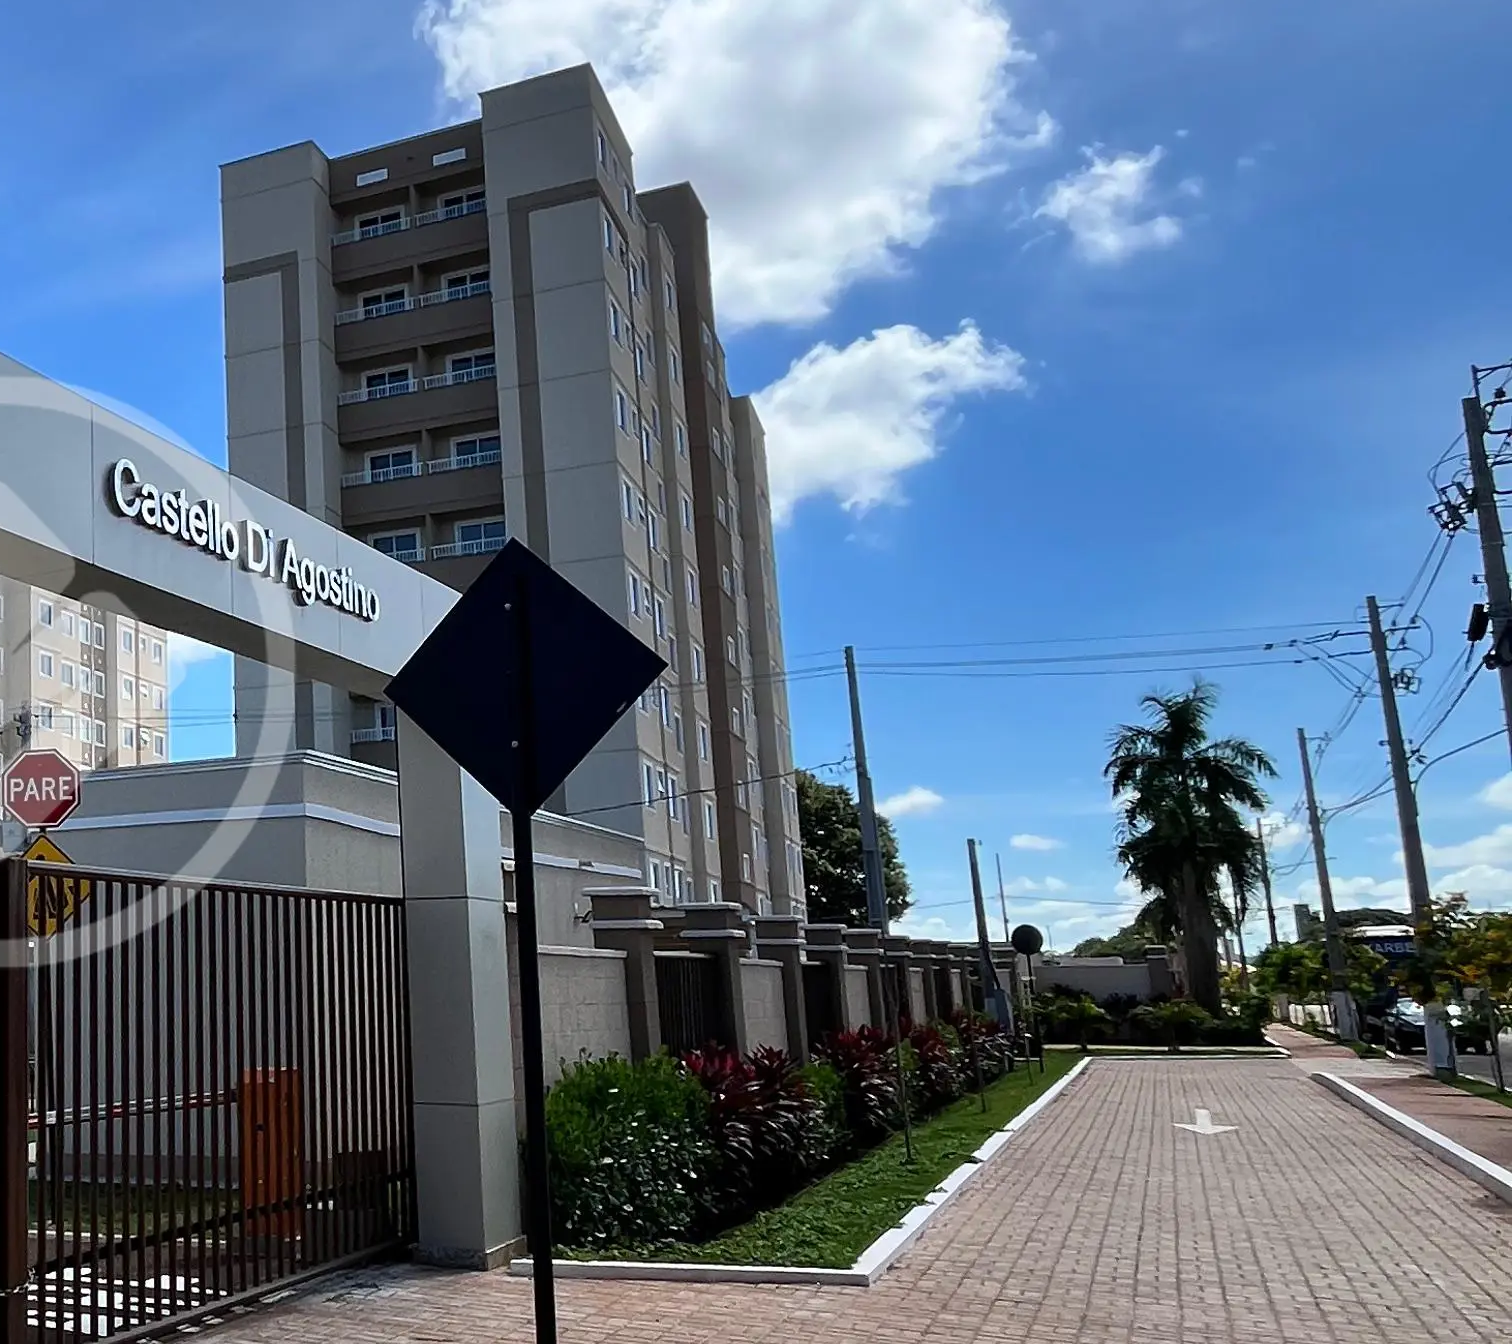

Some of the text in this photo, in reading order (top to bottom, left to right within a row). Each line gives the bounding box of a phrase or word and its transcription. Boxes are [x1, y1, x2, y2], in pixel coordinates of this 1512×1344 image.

[113, 457, 381, 623] Castello Di Agostino
[9, 776, 74, 803] PARE
